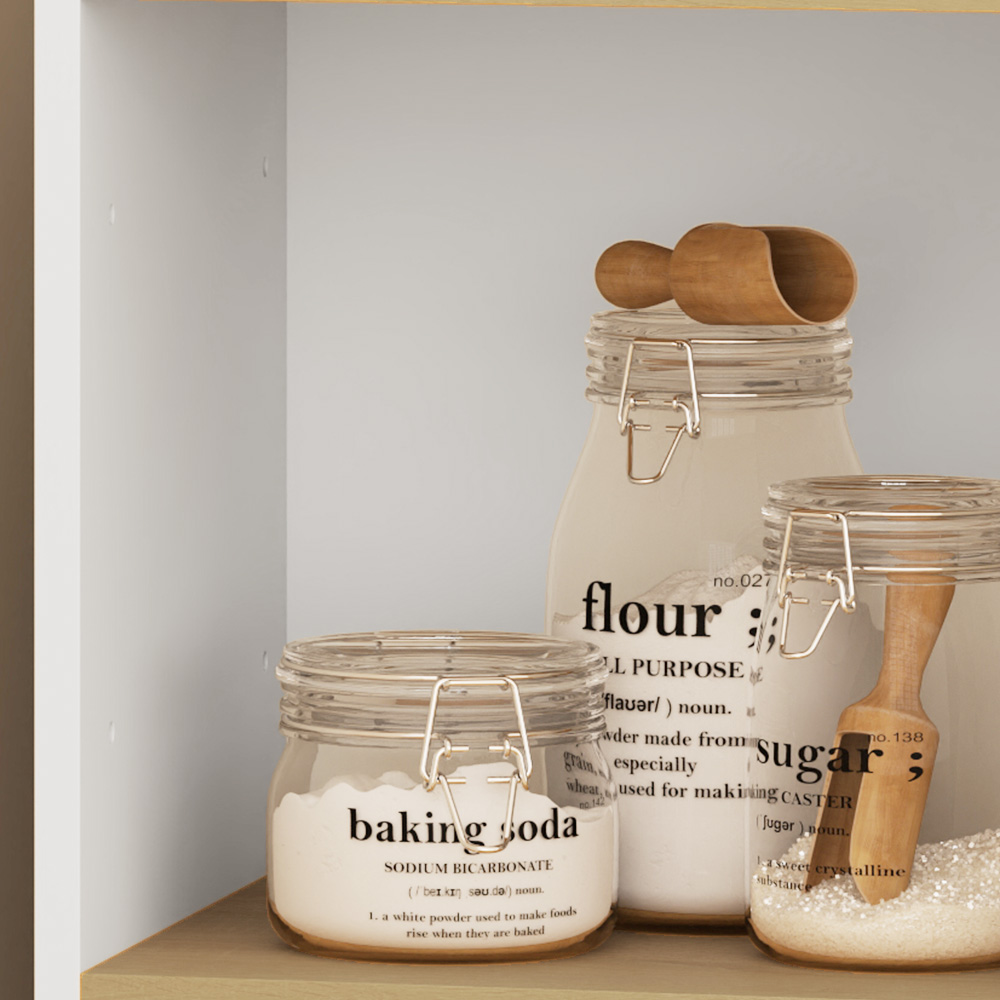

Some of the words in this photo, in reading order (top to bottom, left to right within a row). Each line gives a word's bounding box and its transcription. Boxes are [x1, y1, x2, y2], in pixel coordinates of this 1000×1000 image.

[582, 580, 722, 637] flour
[632, 658, 745, 678] PURPOSE
[679, 703, 732, 715] noun.
[645, 731, 692, 747] made
[699, 731, 746, 747] from
[868, 732, 924, 743] no.138
[614, 757, 698, 778] especially
[757, 738, 884, 784] sugar
[908, 752, 924, 782] ;
[619, 782, 655, 797] used
[662, 782, 688, 798] for
[782, 791, 853, 809] CASTER
[348, 808, 487, 855] baking
[501, 807, 579, 842] soda
[809, 825, 850, 836] noun.
[384, 861, 448, 874] SODIUM
[453, 859, 554, 875] BICARBONATE
[776, 860, 810, 872] sweet
[816, 864, 906, 878] crystalline
[515, 886, 544, 895] noun.
[757, 875, 812, 893] substance
[369, 912, 378, 921] 1.
[393, 911, 426, 922] white
[430, 911, 472, 925] powder
[475, 911, 500, 922] used
[505, 913, 516, 921] to
[519, 910, 547, 920] make
[550, 906, 577, 918] foods
[406, 929, 428, 939] rise
[432, 928, 462, 939] when
[466, 928, 490, 939] they
[493, 930, 510, 938] are
[514, 925, 545, 937] baked
